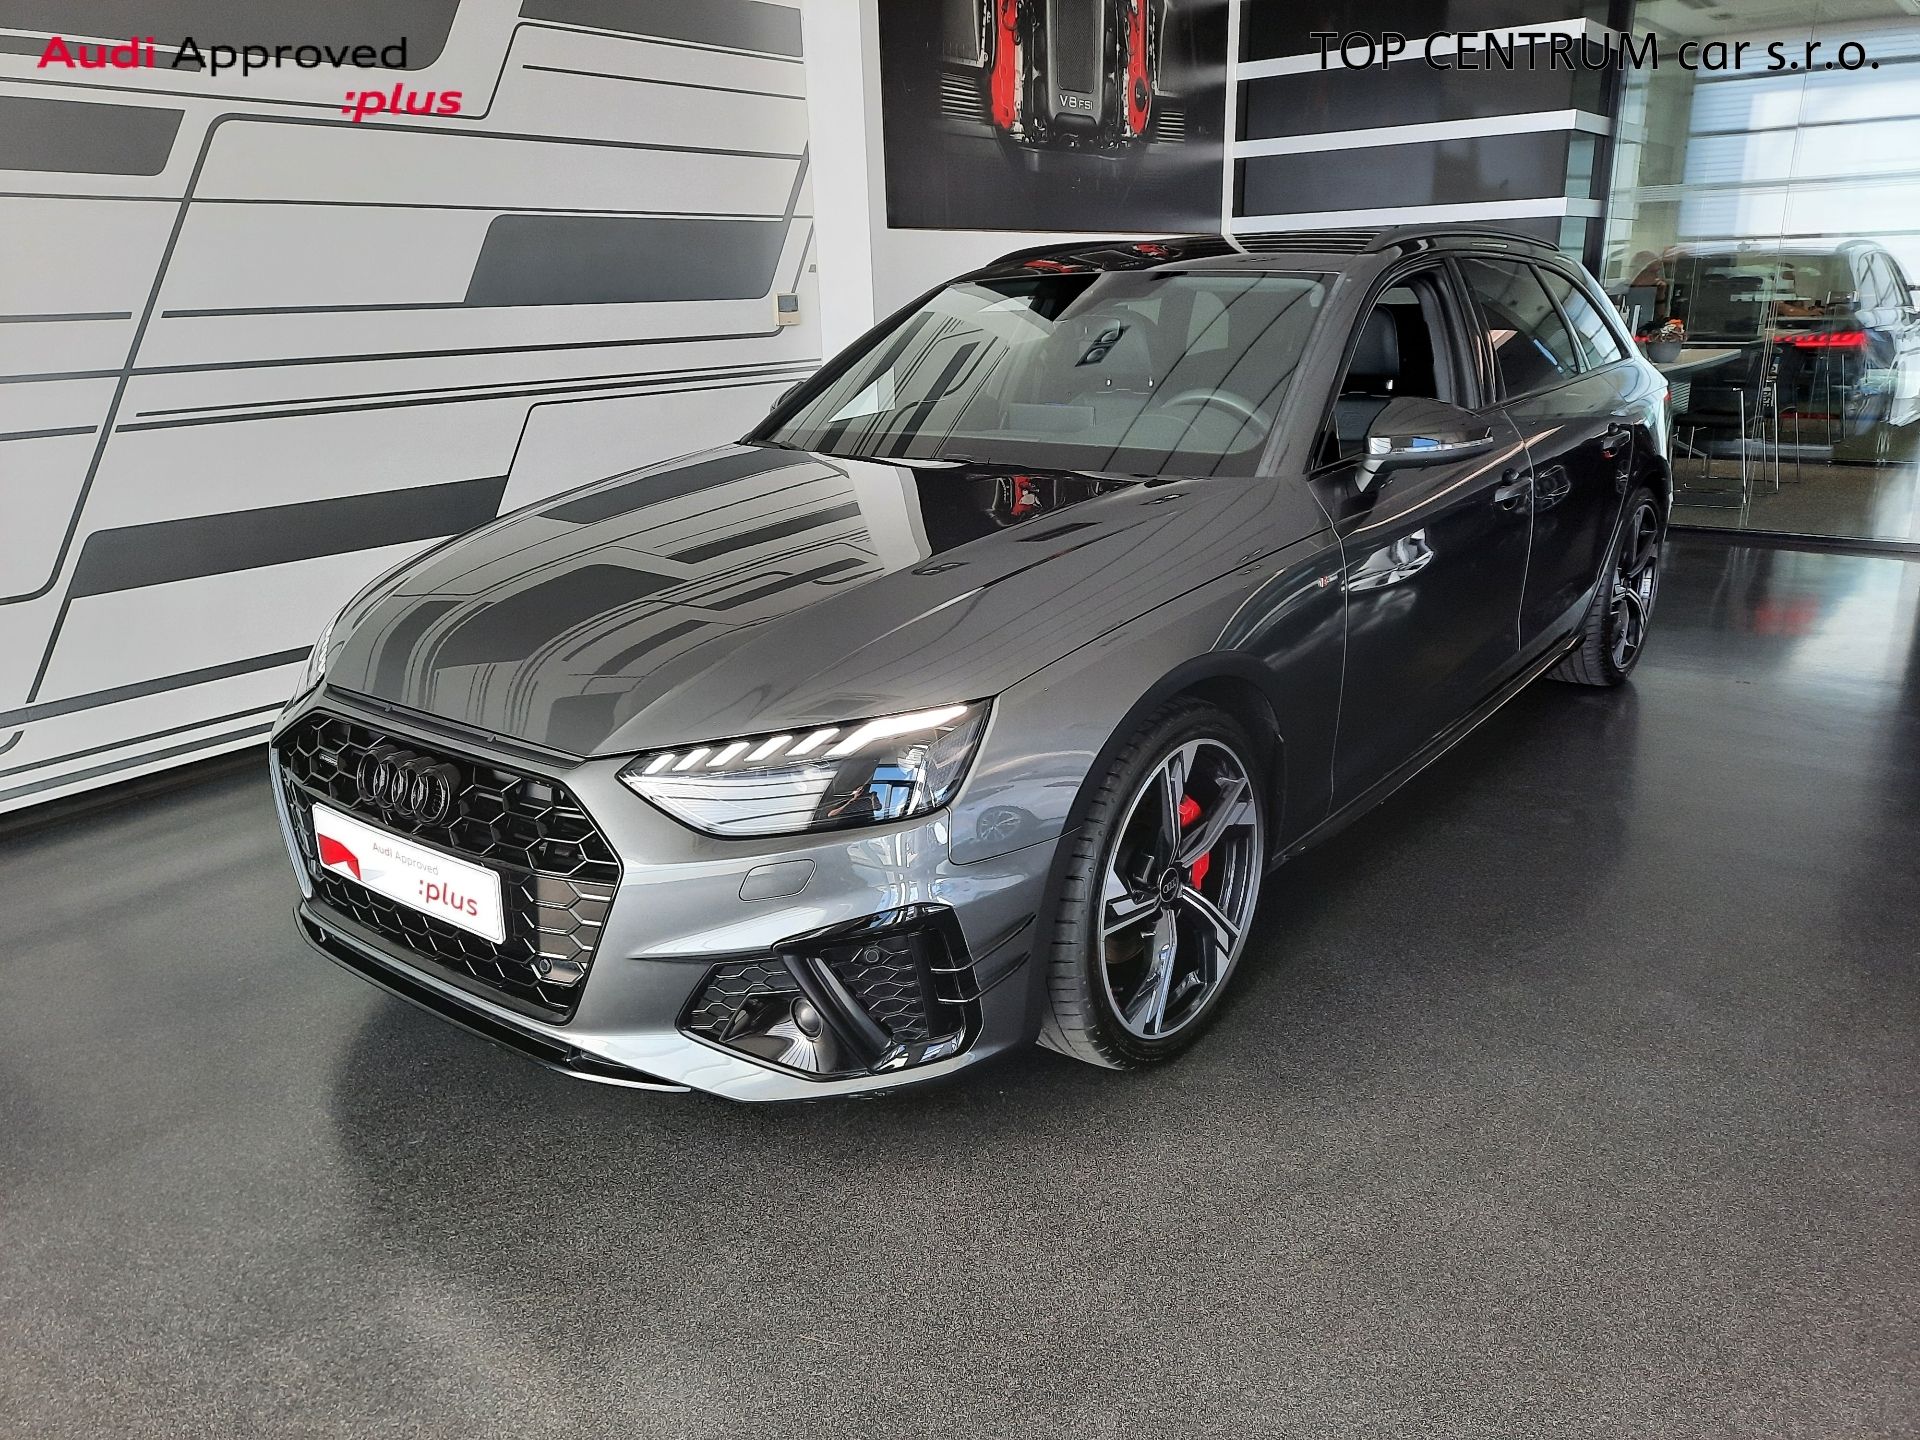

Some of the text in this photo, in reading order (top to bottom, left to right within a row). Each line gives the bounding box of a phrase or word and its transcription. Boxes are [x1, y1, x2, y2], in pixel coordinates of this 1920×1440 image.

[1059, 94, 1093, 110] V8 FSI
[372, 842, 439, 875] Audi Approved
[419, 879, 478, 916] :plus
